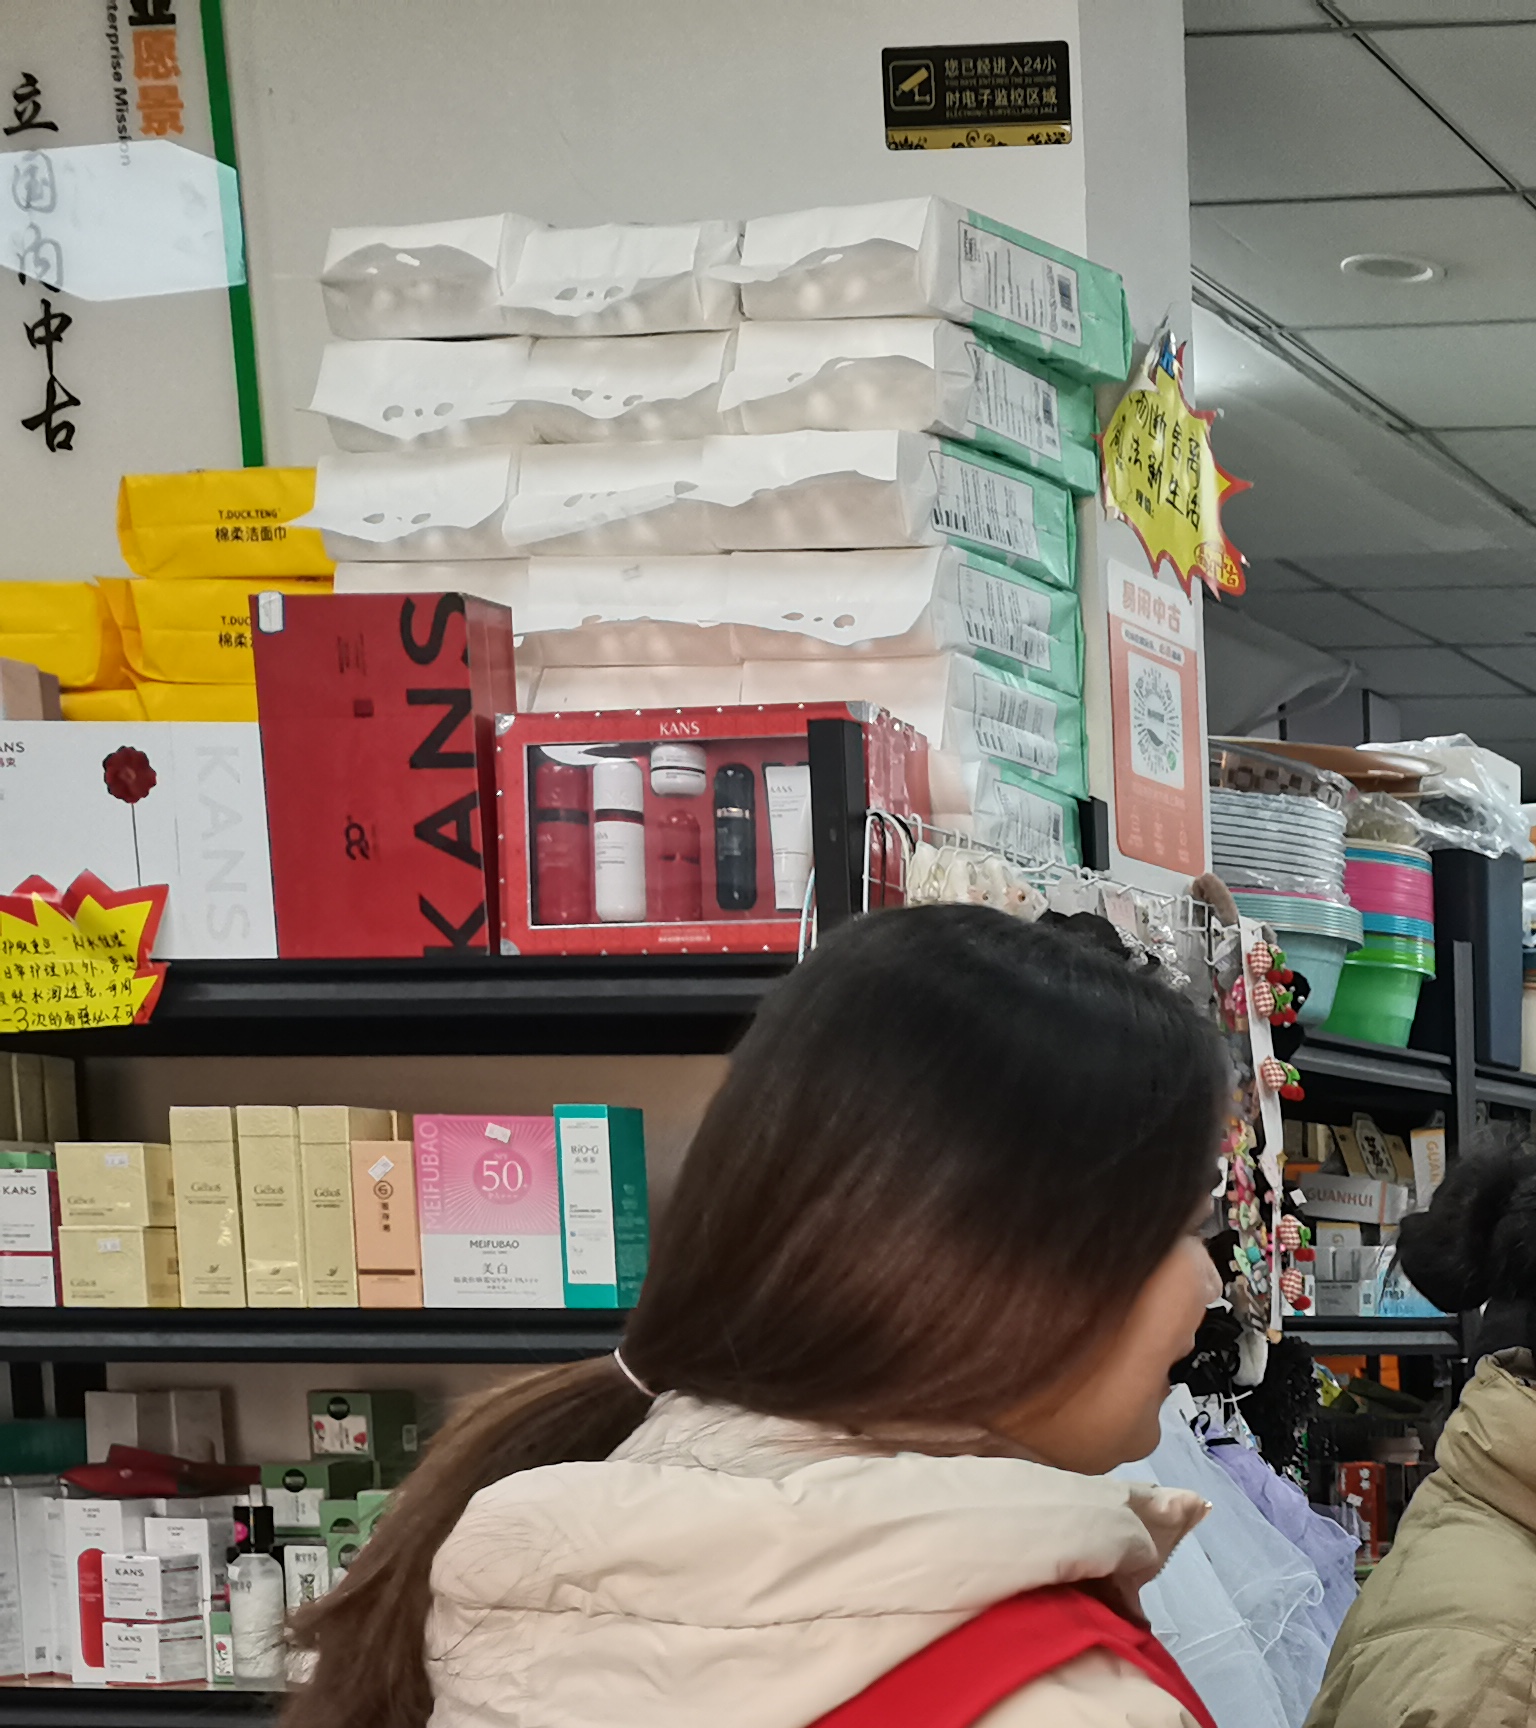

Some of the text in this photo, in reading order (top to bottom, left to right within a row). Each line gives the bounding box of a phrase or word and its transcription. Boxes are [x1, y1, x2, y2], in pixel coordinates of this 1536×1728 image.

[944, 54, 1057, 78] 您已经进入24小
[945, 86, 1058, 108] 时电子监控区域
[114, 87, 133, 167] Mission
[215, 527, 287, 541] 棉柔洁面巾
[218, 632, 254, 648] 棉柔
[659, 721, 701, 736] KANS
[401, 591, 488, 957] KANS
[419, 1121, 442, 1231] MEIFUBAO
[2, 1186, 37, 1195] KANS
[469, 1239, 520, 1249] MEIFUBAO
[483, 1262, 509, 1275] 美白
[114, 1568, 145, 1577] KANS
[117, 1634, 143, 1643] KANS
